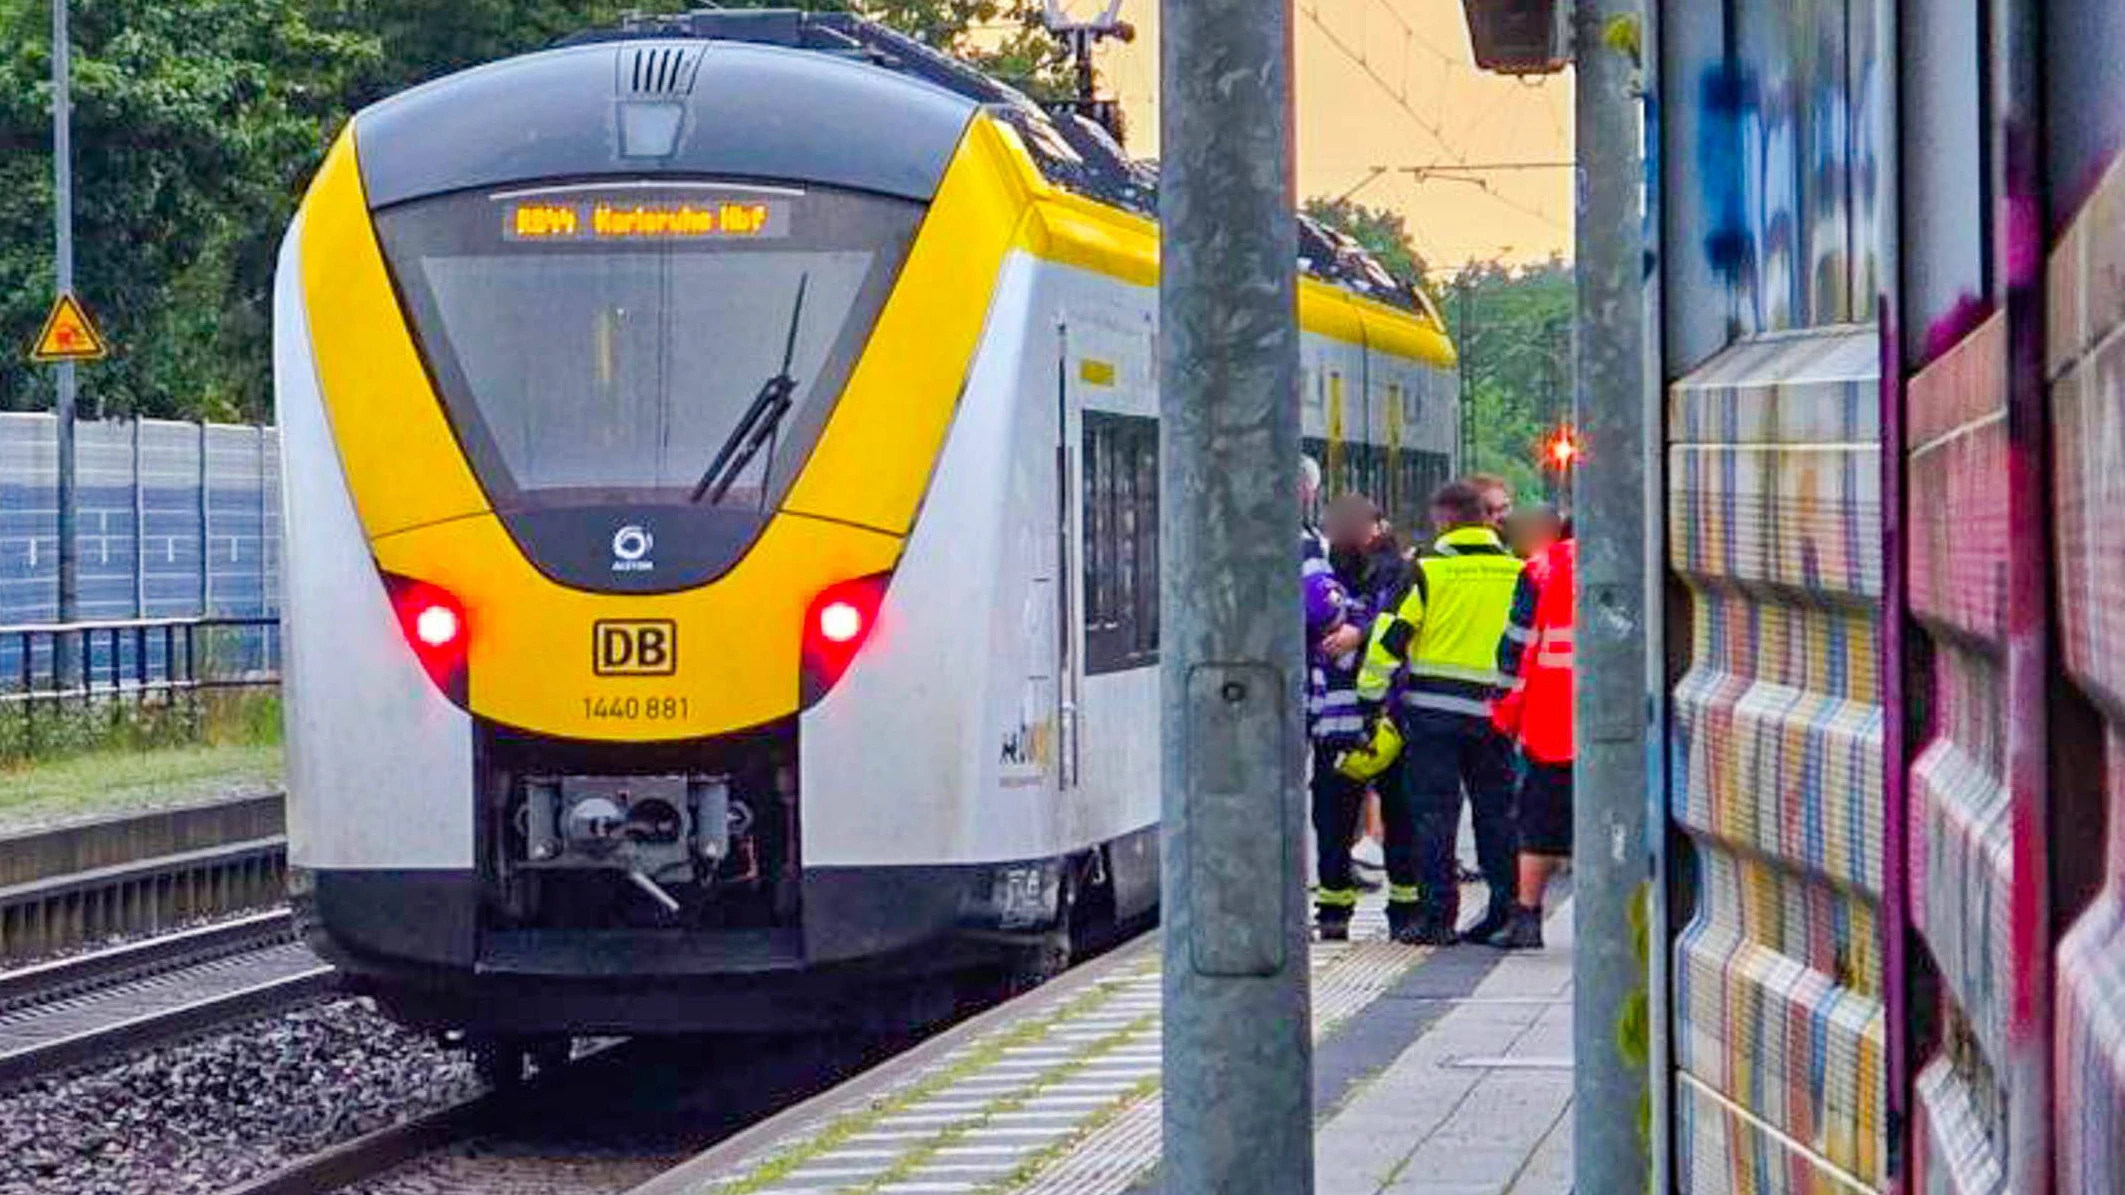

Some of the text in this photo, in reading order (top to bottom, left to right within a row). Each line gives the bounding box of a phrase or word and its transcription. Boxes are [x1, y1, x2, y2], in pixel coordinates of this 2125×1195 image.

[594, 206, 711, 234] Karlsruhe
[720, 205, 766, 232] Hbf
[604, 628, 666, 667] DB
[583, 697, 688, 721] 1440 881
